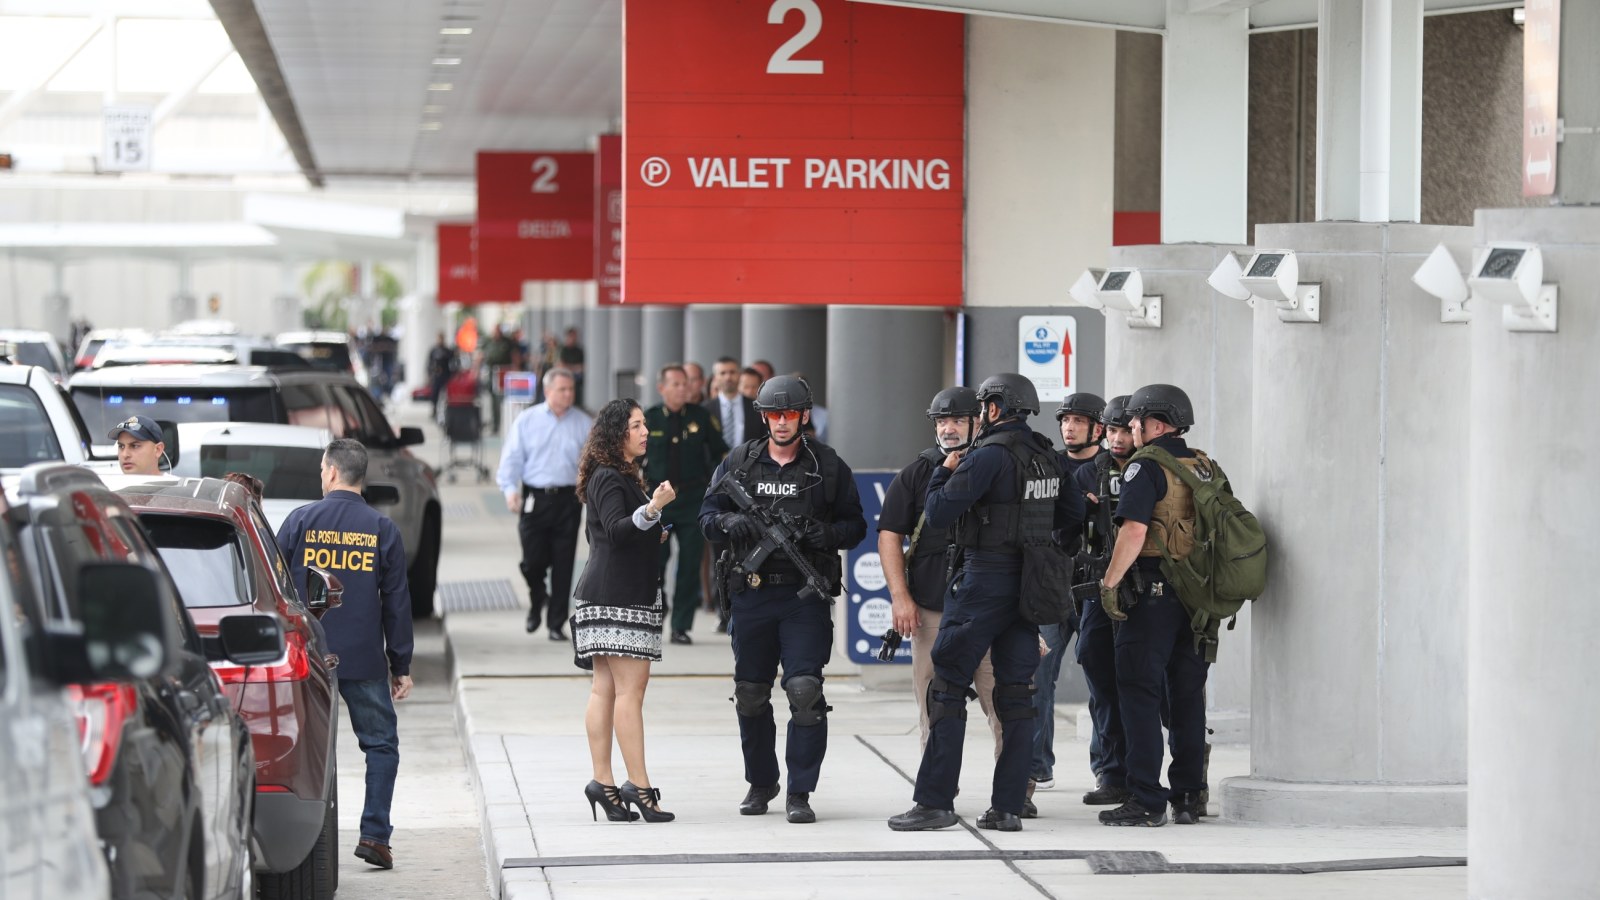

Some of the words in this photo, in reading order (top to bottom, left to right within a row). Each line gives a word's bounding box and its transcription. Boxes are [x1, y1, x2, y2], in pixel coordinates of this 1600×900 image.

[766, 0, 824, 75] 2
[114, 140, 143, 163] 15
[531, 155, 560, 194] 2
[687, 157, 791, 188] VALET
[804, 158, 950, 190] PARKING
[517, 220, 572, 239] DELTA
[756, 482, 797, 496] POLICE
[305, 530, 316, 542] U.S.
[318, 531, 341, 544] POSTAL
[342, 532, 378, 547] INSPECTOR
[303, 548, 374, 571] POLICE
